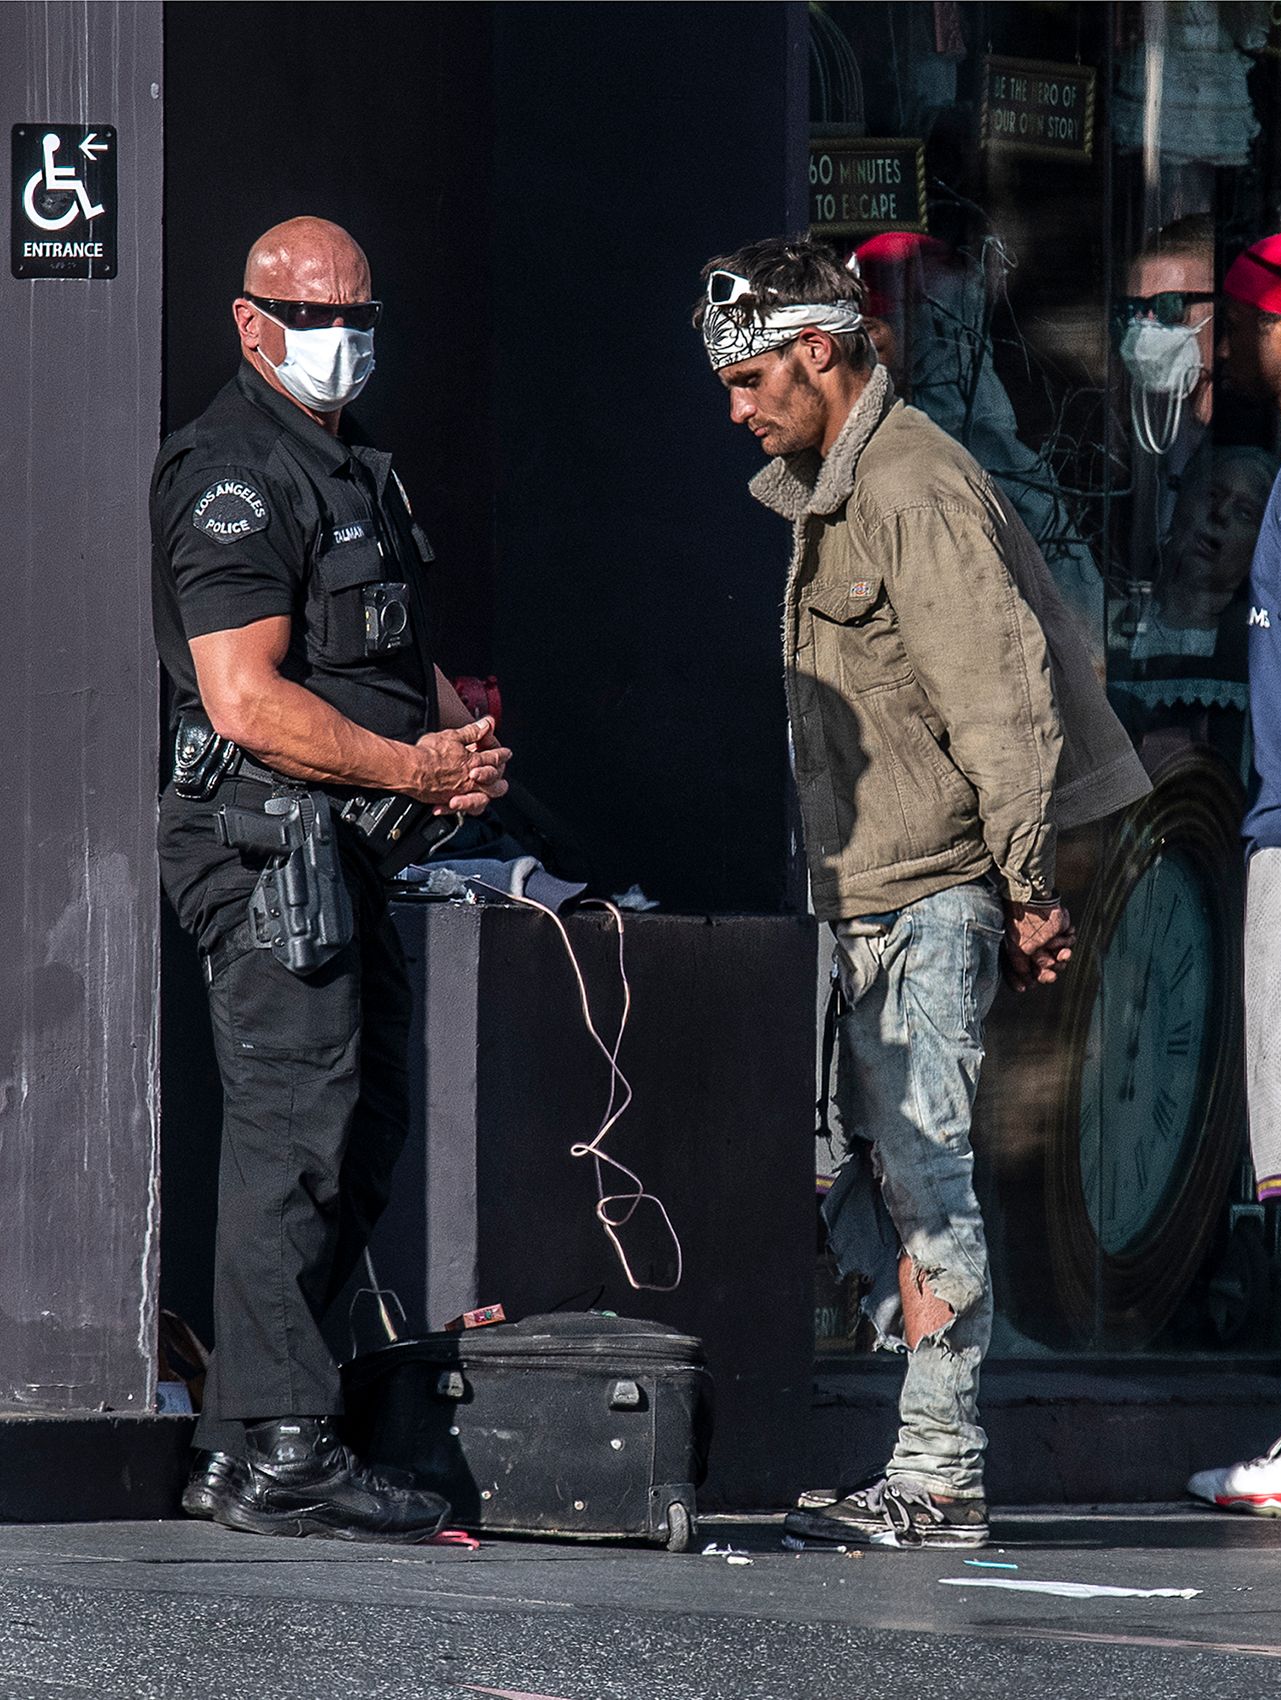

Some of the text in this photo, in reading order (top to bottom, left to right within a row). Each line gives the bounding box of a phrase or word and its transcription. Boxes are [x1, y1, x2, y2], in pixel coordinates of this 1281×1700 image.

[1010, 77, 1028, 102] THE
[1031, 81, 1059, 107] ERO
[1062, 85, 1078, 108] OF
[991, 107, 1017, 133] OUR
[1047, 115, 1081, 141] STORY
[809, 154, 833, 185] 60
[815, 193, 836, 219] TO
[23, 242, 104, 258] ENTRANCE
[194, 482, 266, 518] LOS ANGELES
[205, 519, 251, 534] POLICE
